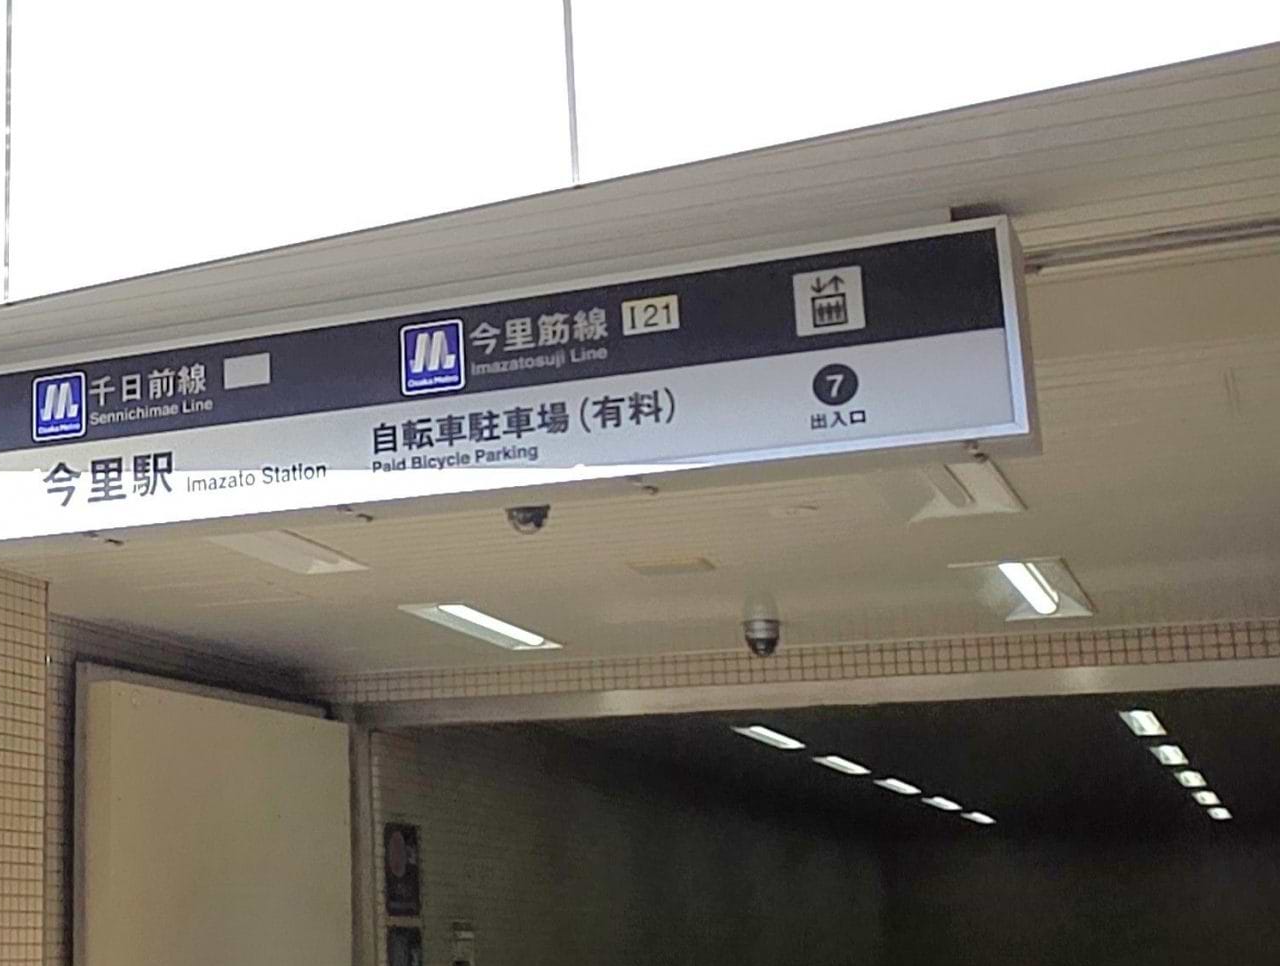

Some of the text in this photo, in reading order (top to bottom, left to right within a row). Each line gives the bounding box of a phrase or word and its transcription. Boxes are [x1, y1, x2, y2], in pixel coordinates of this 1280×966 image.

[470, 307, 609, 355] 今里筋線
[471, 346, 608, 376] Imazatosuji Line
[88, 363, 207, 406] 千日前線
[826, 374, 843, 397] 7
[90, 398, 213, 426] Sennichimae Line
[810, 410, 866, 430] 出入口
[372, 445, 538, 473] Paid Bicycle Parking
[43, 451, 174, 507] 今里駅
[186, 463, 327, 493] Imazato Station
